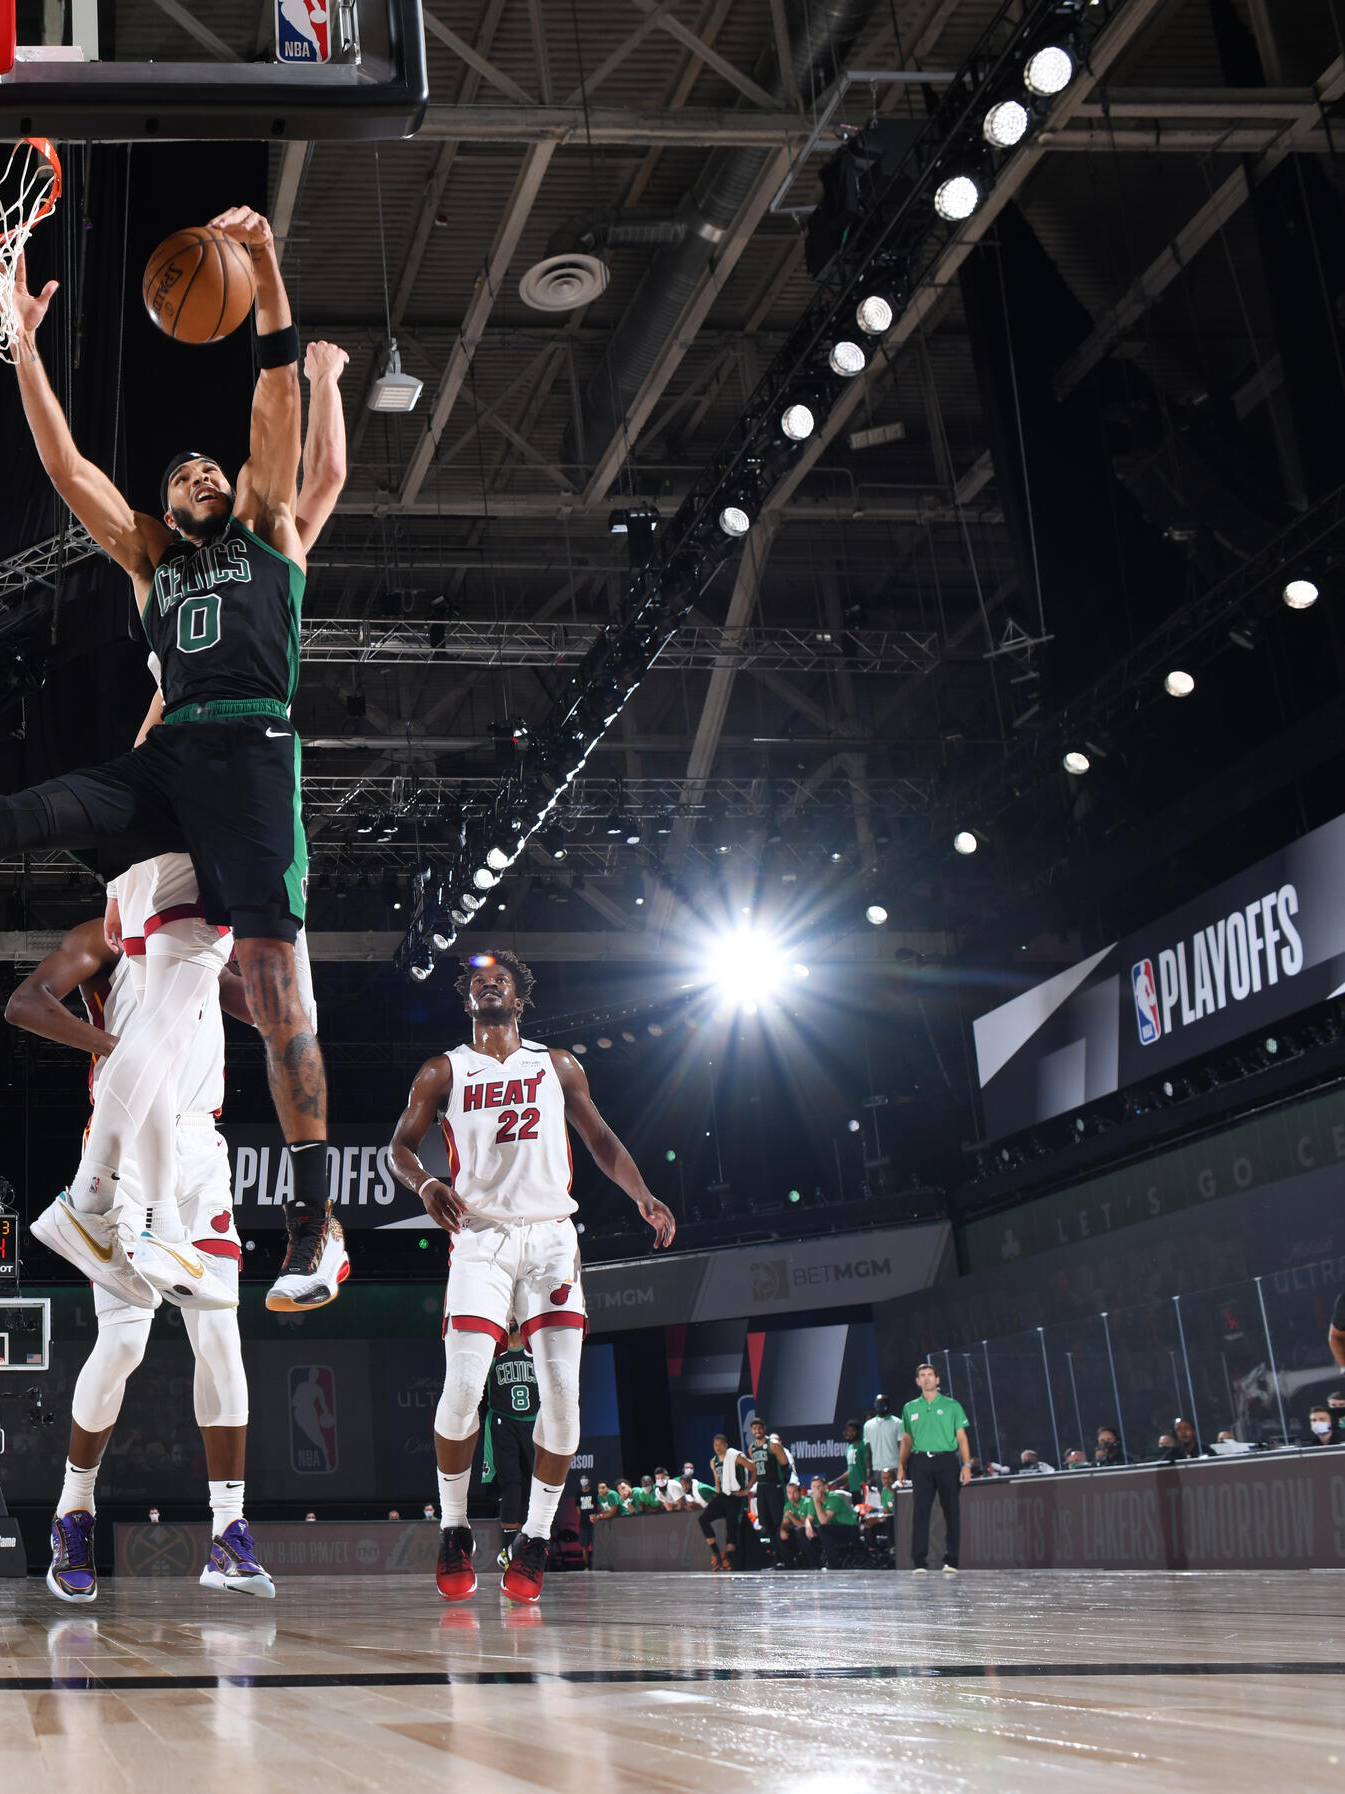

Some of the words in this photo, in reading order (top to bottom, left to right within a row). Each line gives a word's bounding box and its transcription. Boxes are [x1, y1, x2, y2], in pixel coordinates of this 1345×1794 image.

[284, 41, 311, 57] NBA
[176, 593, 222, 654] 0
[1158, 883, 1304, 1035] PLAYOFFS
[463, 1067, 546, 1113] HEAT
[495, 1107, 541, 1144] 22
[233, 1146, 396, 1206] PLAOFFS
[1198, 1157, 1254, 1199] GO
[792, 1257, 892, 1288] BETMGM
[584, 1287, 655, 1310] ETMGM
[397, 1391, 439, 1408] ULT
[511, 1385, 530, 1411] 8
[297, 1450, 320, 1467] NBA
[790, 1440, 849, 1459] #WholeNew
[1081, 1487, 1157, 1561] LAKERS
[1166, 1474, 1317, 1560] TOMORROW
[277, 1540, 305, 1564] 9:00
[309, 1540, 349, 1564] PM/ET
